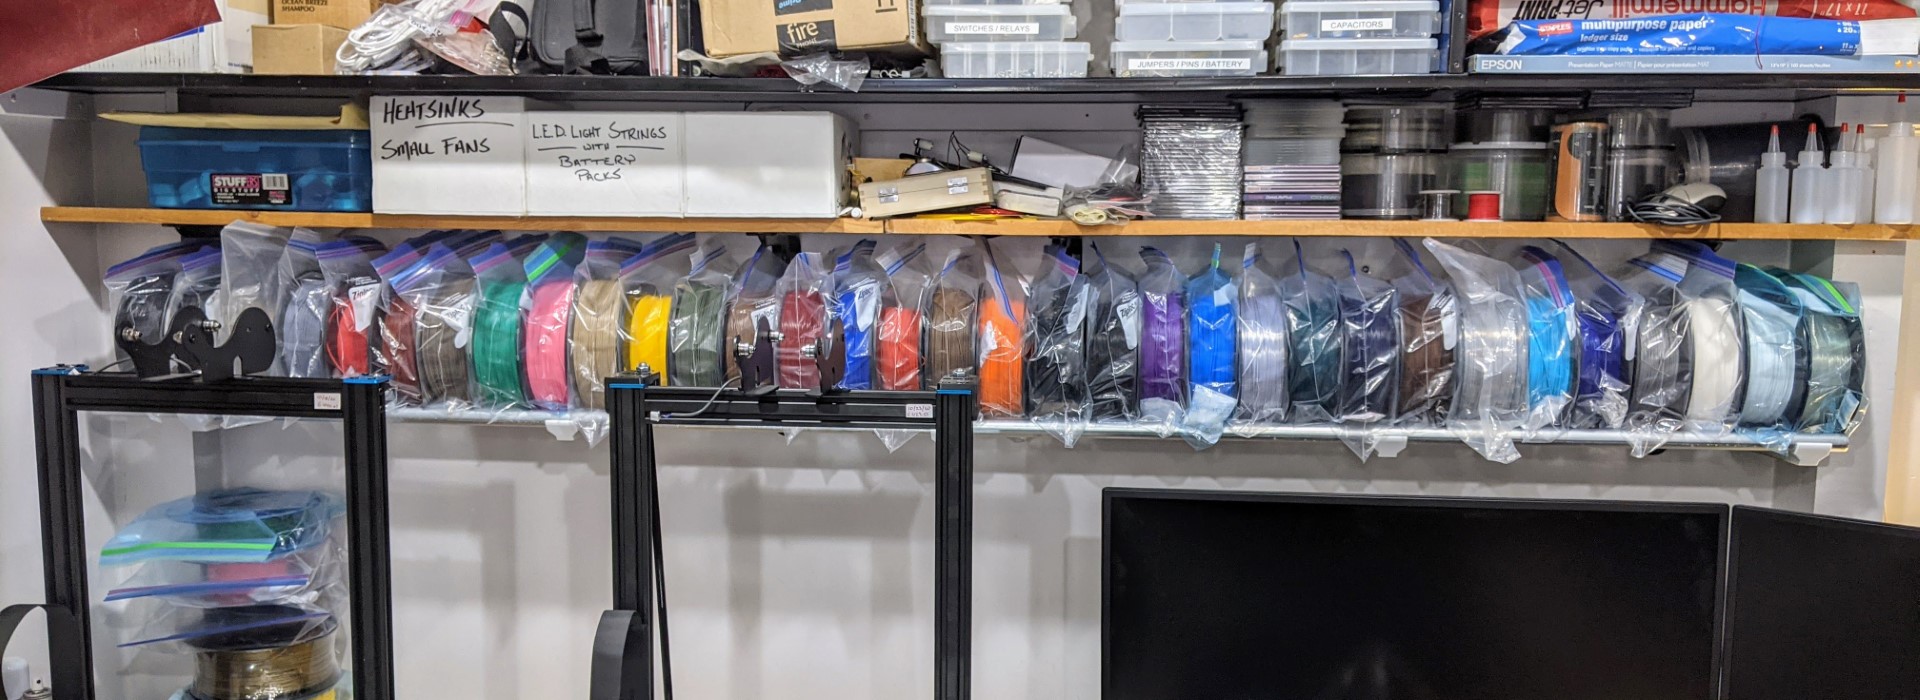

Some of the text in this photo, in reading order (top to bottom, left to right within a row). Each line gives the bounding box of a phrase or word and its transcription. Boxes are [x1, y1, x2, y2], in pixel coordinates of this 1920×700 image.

[1612, 0, 1766, 18] Hammermill
[1854, 3, 1868, 16] 11
[953, 25, 994, 33] SWITCHES
[1000, 25, 1031, 33] RELAYS
[1330, 20, 1384, 29] CAPACITORS
[1581, 19, 1708, 32] multipurpose paper
[787, 22, 819, 43] fire
[1579, 33, 1629, 43] ledger size
[1481, 60, 1523, 70] EPSON
[383, 97, 485, 124] HEATSINKS
[570, 125, 602, 139] LIGHT
[608, 121, 667, 140] STRINGS
[381, 136, 491, 160] SMALL FANS
[583, 143, 610, 151] WITH
[558, 154, 637, 168] BATTERY
[575, 168, 622, 182] PACKS
